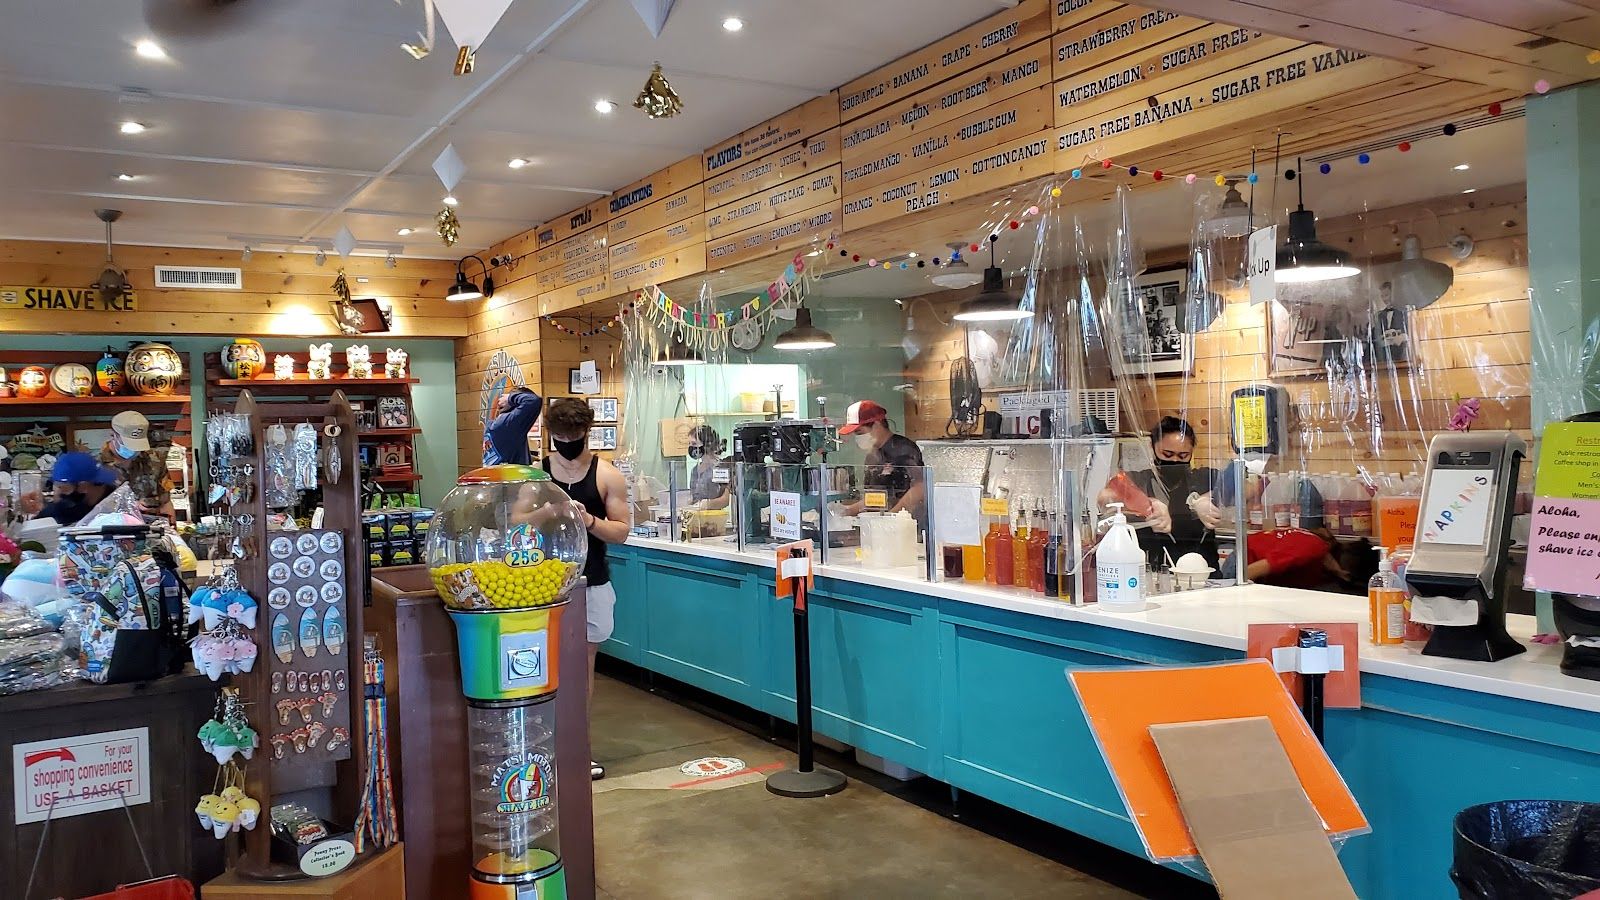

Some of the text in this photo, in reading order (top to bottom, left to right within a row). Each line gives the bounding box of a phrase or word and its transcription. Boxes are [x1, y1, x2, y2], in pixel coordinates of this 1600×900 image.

[1058, 9, 1179, 61] STRAWBERRY CREA
[842, 21, 1019, 111] SOUR APPLE BANANA GRAPE CHERRY
[1059, 28, 1249, 107] WATERMELON SUGAR FREE
[861, 120, 891, 141] COLADA
[901, 104, 930, 126] MELON
[941, 91, 965, 109] ROOT
[966, 80, 988, 100] BEER
[1001, 59, 1039, 85] MANGO
[1059, 127, 1096, 150] SUGAR
[1100, 115, 1131, 138] FREE
[1134, 97, 1193, 126] BANANA
[1211, 75, 1261, 103] SUGAR
[1266, 61, 1307, 87] FREE
[707, 143, 742, 171] FLAVORS
[843, 110, 1016, 182] PICKLED MANGO VANILLA BUBBLE GUM
[741, 162, 773, 183] RASPBERRY
[779, 150, 801, 168] LYCHEE
[844, 139, 1048, 215] ORANGE COCONUT LEMON COTTON CANDY
[708, 176, 833, 228] LIME STRAWBERRY WHITE CAKE GUAVA
[906, 191, 940, 212] PEACH
[769, 222, 801, 241] LEMONADE
[1258, 257, 1270, 277] Up
[24, 288, 94, 309] SHAVE
[104, 364, 119, 390] 松本
[239, 362, 251, 378] 松本
[1387, 508, 1405, 516] Aloha
[1423, 475, 1488, 540] NAPKINS
[1537, 505, 1580, 518] Aloha,
[1538, 526, 1580, 540] Please
[511, 551, 539, 566] 25¢
[1538, 543, 1594, 556] shave ice
[104, 744, 133, 758] For your
[33, 758, 133, 790] shopping convenience
[34, 779, 134, 808] USE A BASKET
[499, 797, 549, 813] SHAVE ICE
[310, 850, 346, 864] Collector's Book
[314, 845, 342, 857] Penny Press
